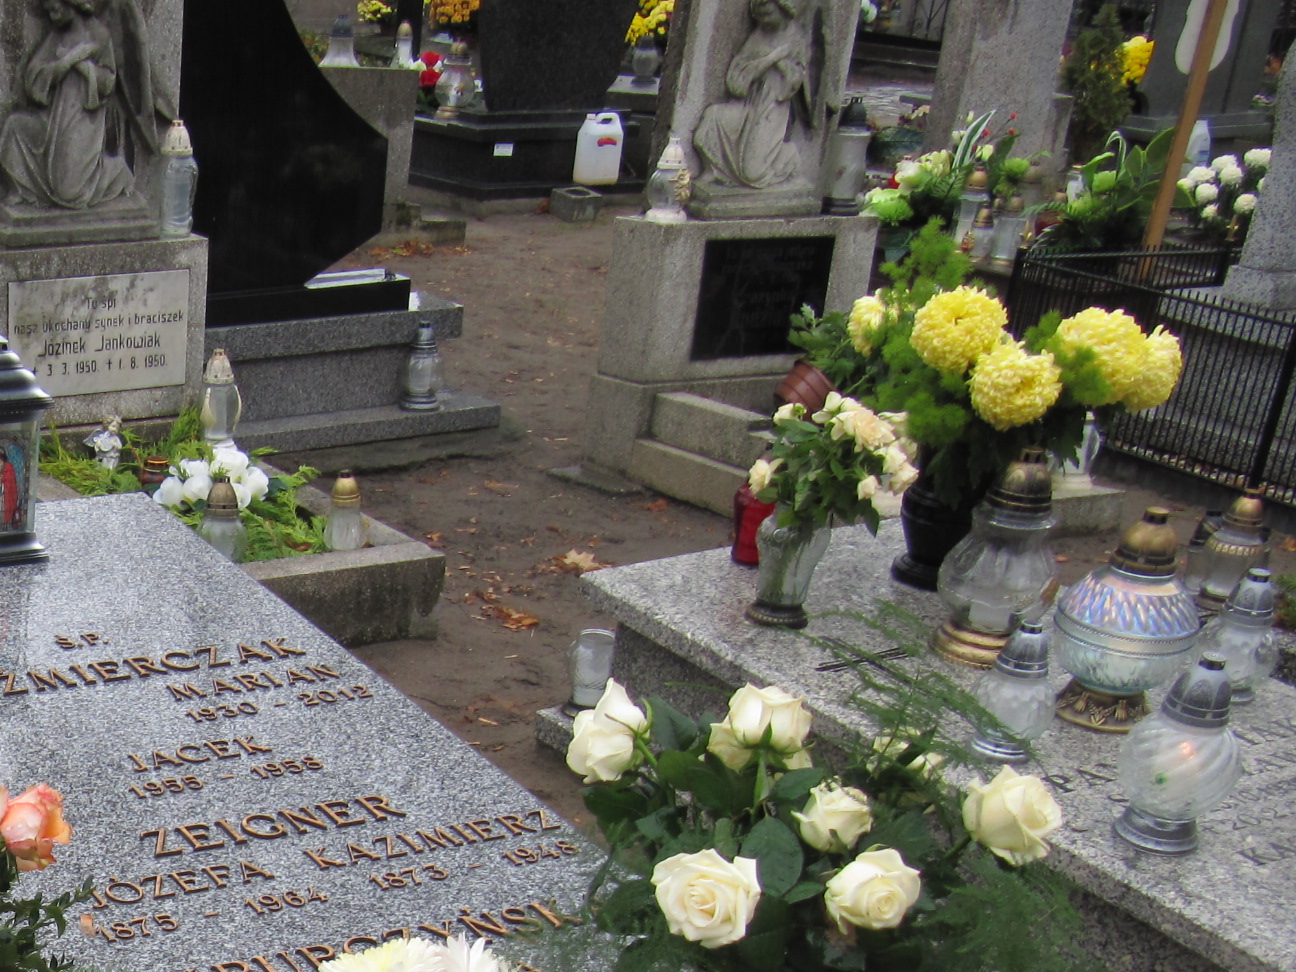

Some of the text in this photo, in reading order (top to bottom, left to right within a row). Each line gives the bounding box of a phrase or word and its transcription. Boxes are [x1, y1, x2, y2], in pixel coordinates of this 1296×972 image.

[14, 323, 37, 335] nasz
[94, 314, 124, 331] synek
[134, 310, 184, 324] braciszek
[94, 331, 161, 352] Jankowiak
[55, 633, 110, 650] Ś.P.
[166, 664, 341, 701] MARIAN
[186, 701, 259, 723] 1930
[298, 685, 374, 706] 2012
[128, 736, 273, 772] JACEK
[129, 775, 204, 799] 1955
[251, 756, 324, 779] 1958
[140, 795, 407, 858] ZEIGNER
[91, 809, 561, 909] JÓZEFA KAZIMIERZ
[96, 914, 179, 943] 1875
[245, 886, 329, 915] 1964
[370, 864, 449, 890] 1873
[502, 840, 580, 866] 1948
